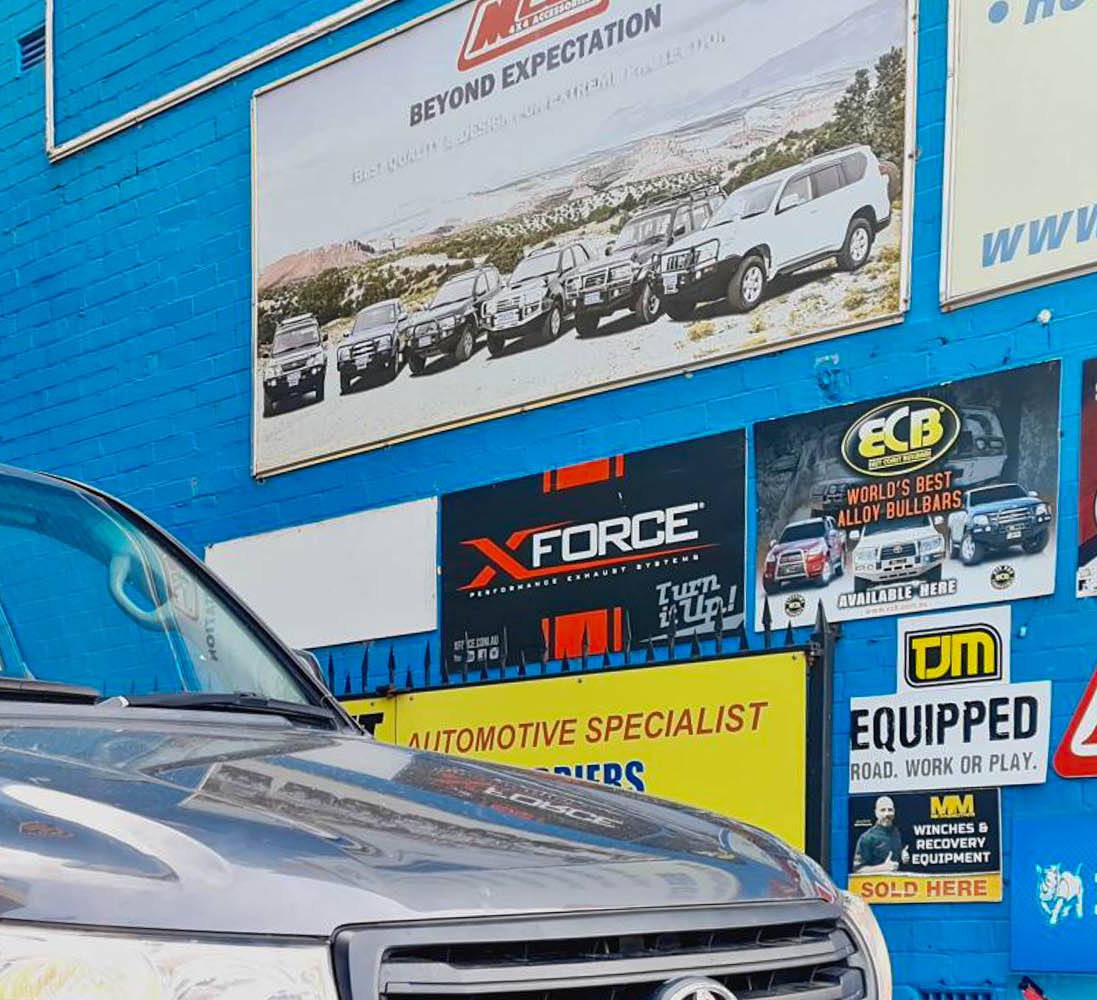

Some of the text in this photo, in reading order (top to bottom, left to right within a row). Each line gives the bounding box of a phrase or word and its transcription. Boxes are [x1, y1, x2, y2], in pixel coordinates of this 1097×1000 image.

[410, 73, 496, 127] BEYOND
[501, 4, 662, 89] EXPECTATION
[858, 406, 944, 458] ECB
[847, 471, 952, 505] WORLD'S BEST
[837, 490, 963, 527] ALLOY BULLBARS
[457, 502, 701, 591] XFORCE
[469, 554, 700, 598] PERFORMANCE EXHAUST SYSTEMS
[655, 574, 721, 606] Turn
[838, 578, 957, 609] AVAILABLE HERE
[911, 631, 995, 680] TJM
[408, 719, 577, 754] AUTOMOTIVE
[585, 702, 769, 742] SPECIALIST
[850, 695, 1039, 753] EQUIPPED
[850, 751, 1037, 781] ROAD. WORK OR PLAY.
[913, 821, 988, 836] WINCHES &
[915, 837, 986, 850] RECOVERY
[912, 851, 991, 865] EQUIPMENT
[861, 879, 987, 898] SOLD HERE
